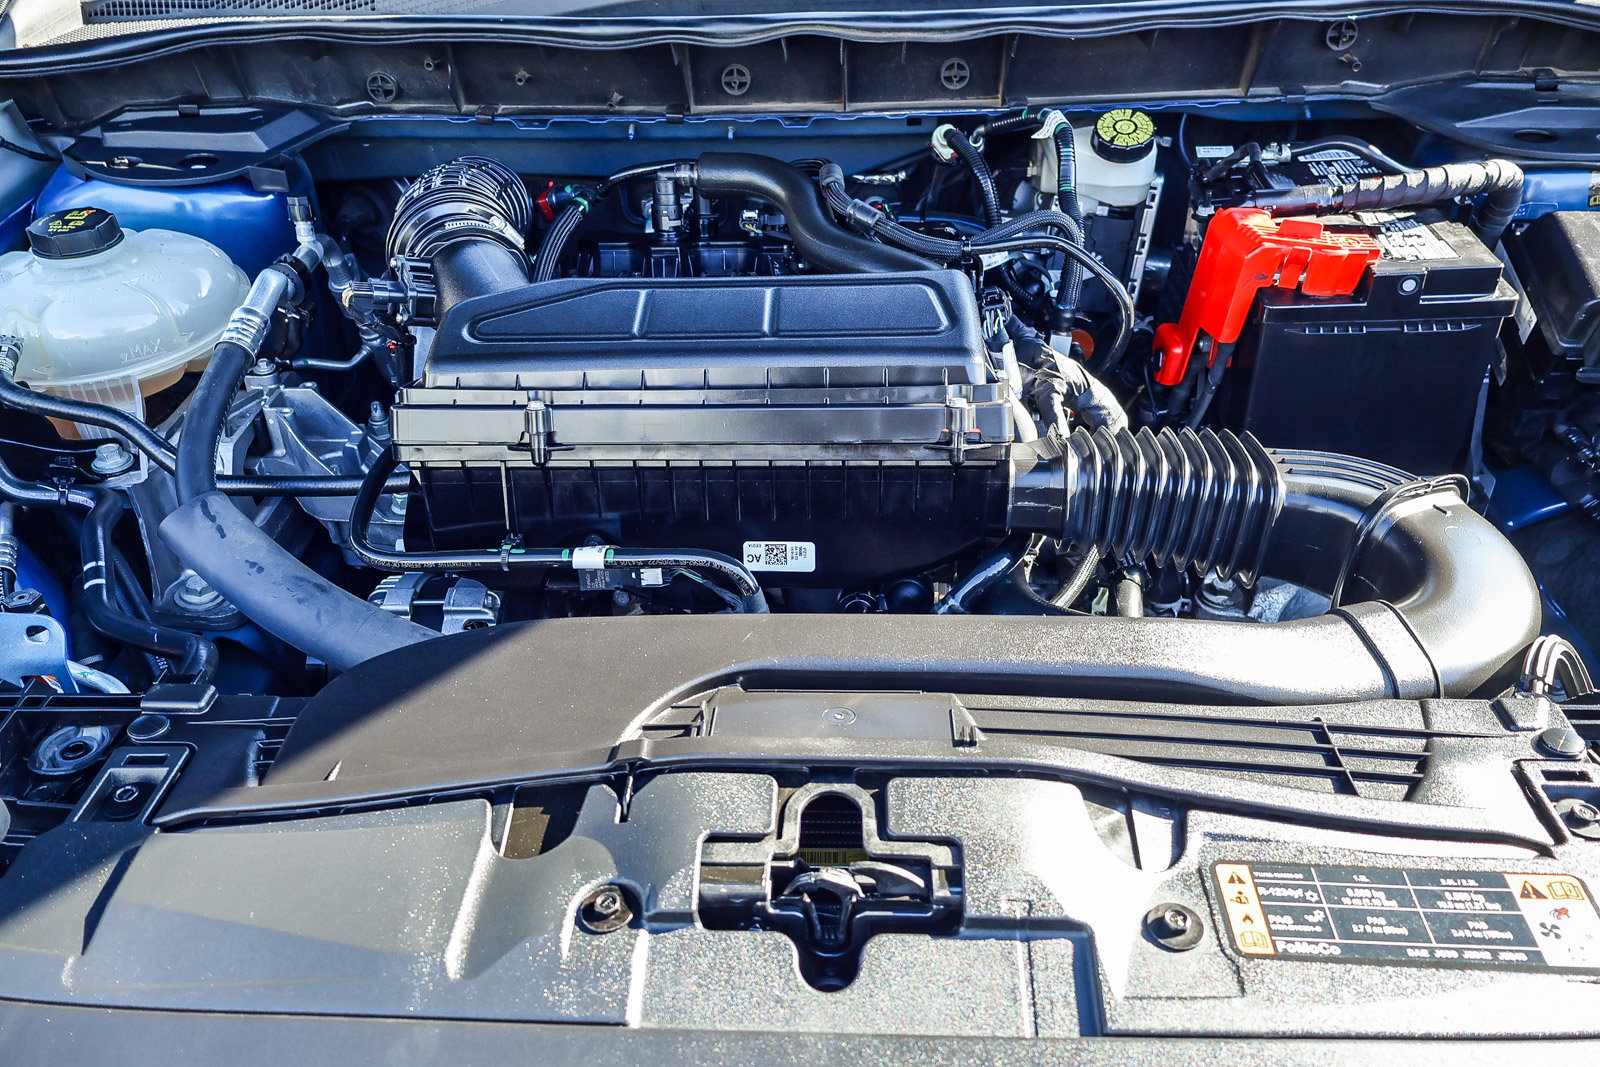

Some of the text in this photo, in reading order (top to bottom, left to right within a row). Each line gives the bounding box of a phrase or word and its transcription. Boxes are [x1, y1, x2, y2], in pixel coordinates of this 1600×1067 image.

[128, 338, 166, 358] MAX
[746, 554, 762, 563] AC
[1276, 941, 1342, 955] FoMoCo
